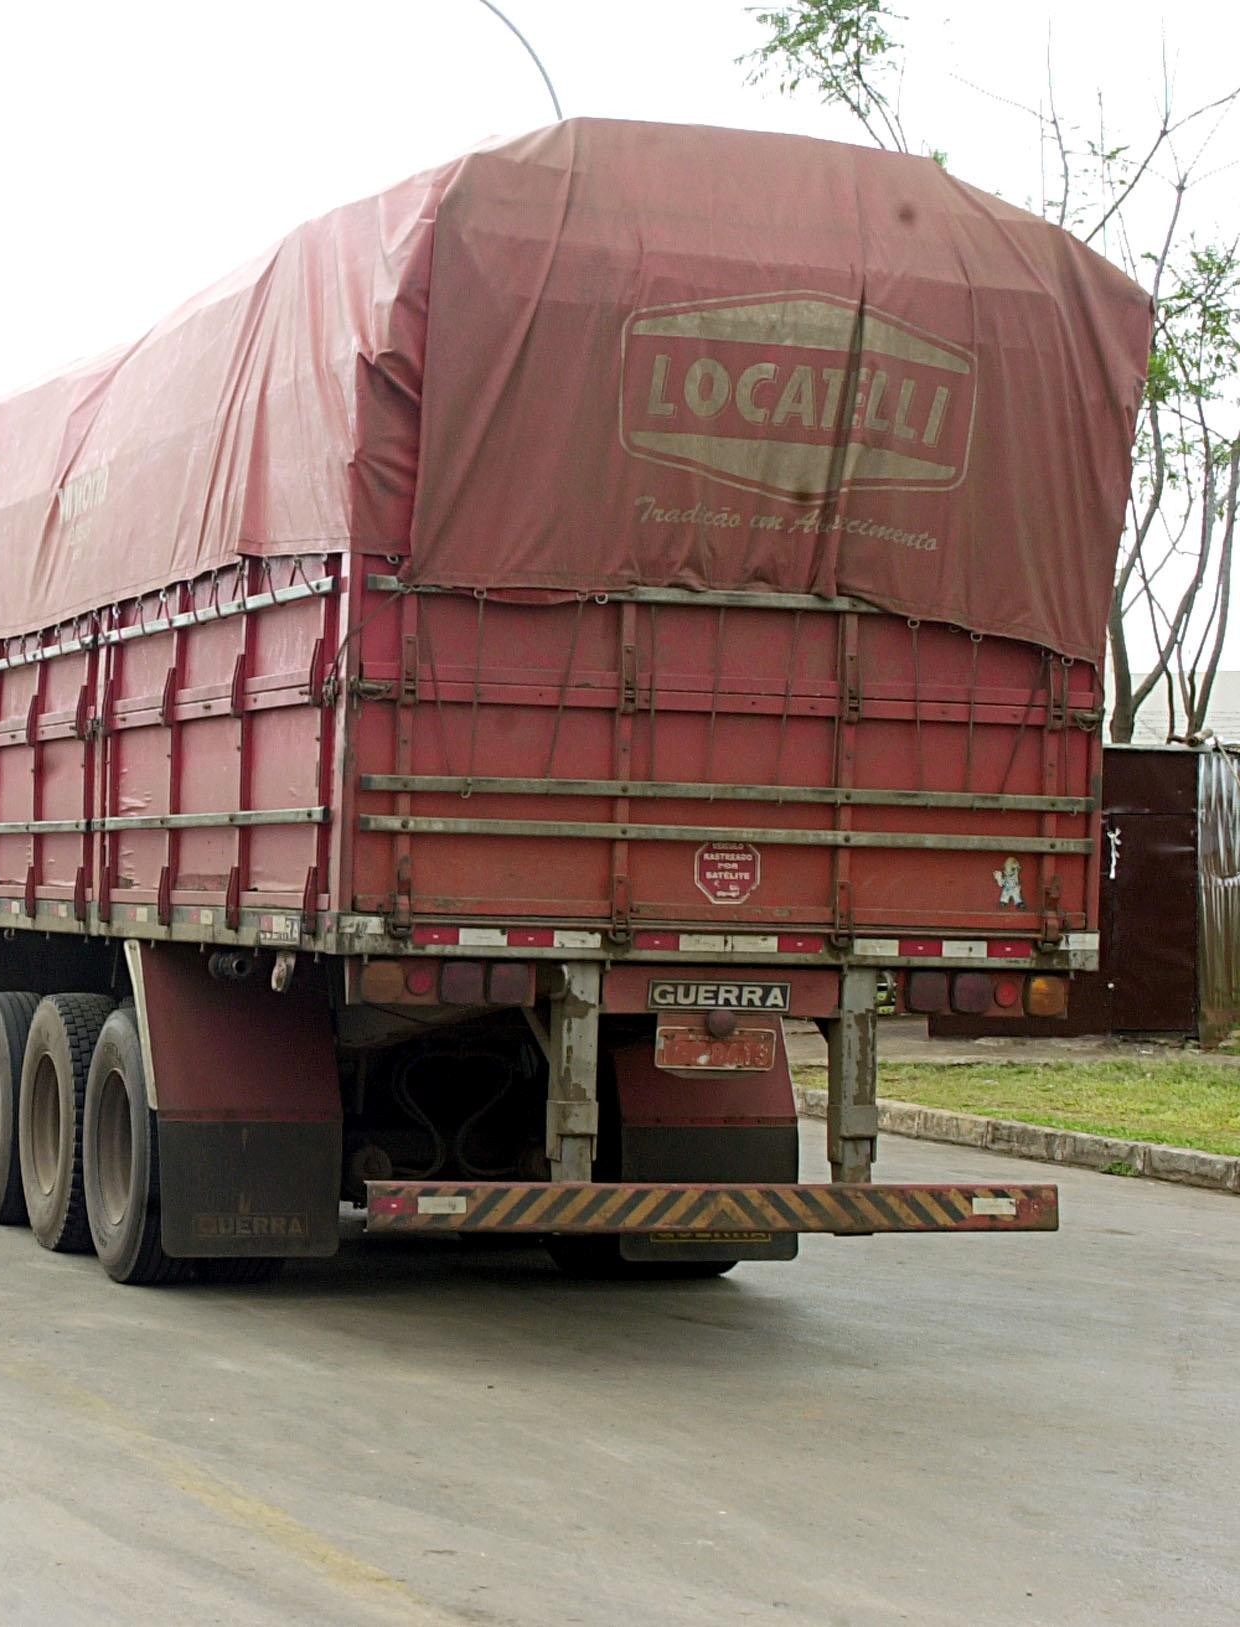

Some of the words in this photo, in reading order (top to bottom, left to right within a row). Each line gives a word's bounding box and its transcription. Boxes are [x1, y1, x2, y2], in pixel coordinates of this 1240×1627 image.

[749, 515, 783, 531] em
[703, 852, 753, 861] RASTREADO
[717, 862, 739, 870] POR
[653, 984, 784, 1008] GUERRA
[197, 1215, 306, 1235] UERRA
